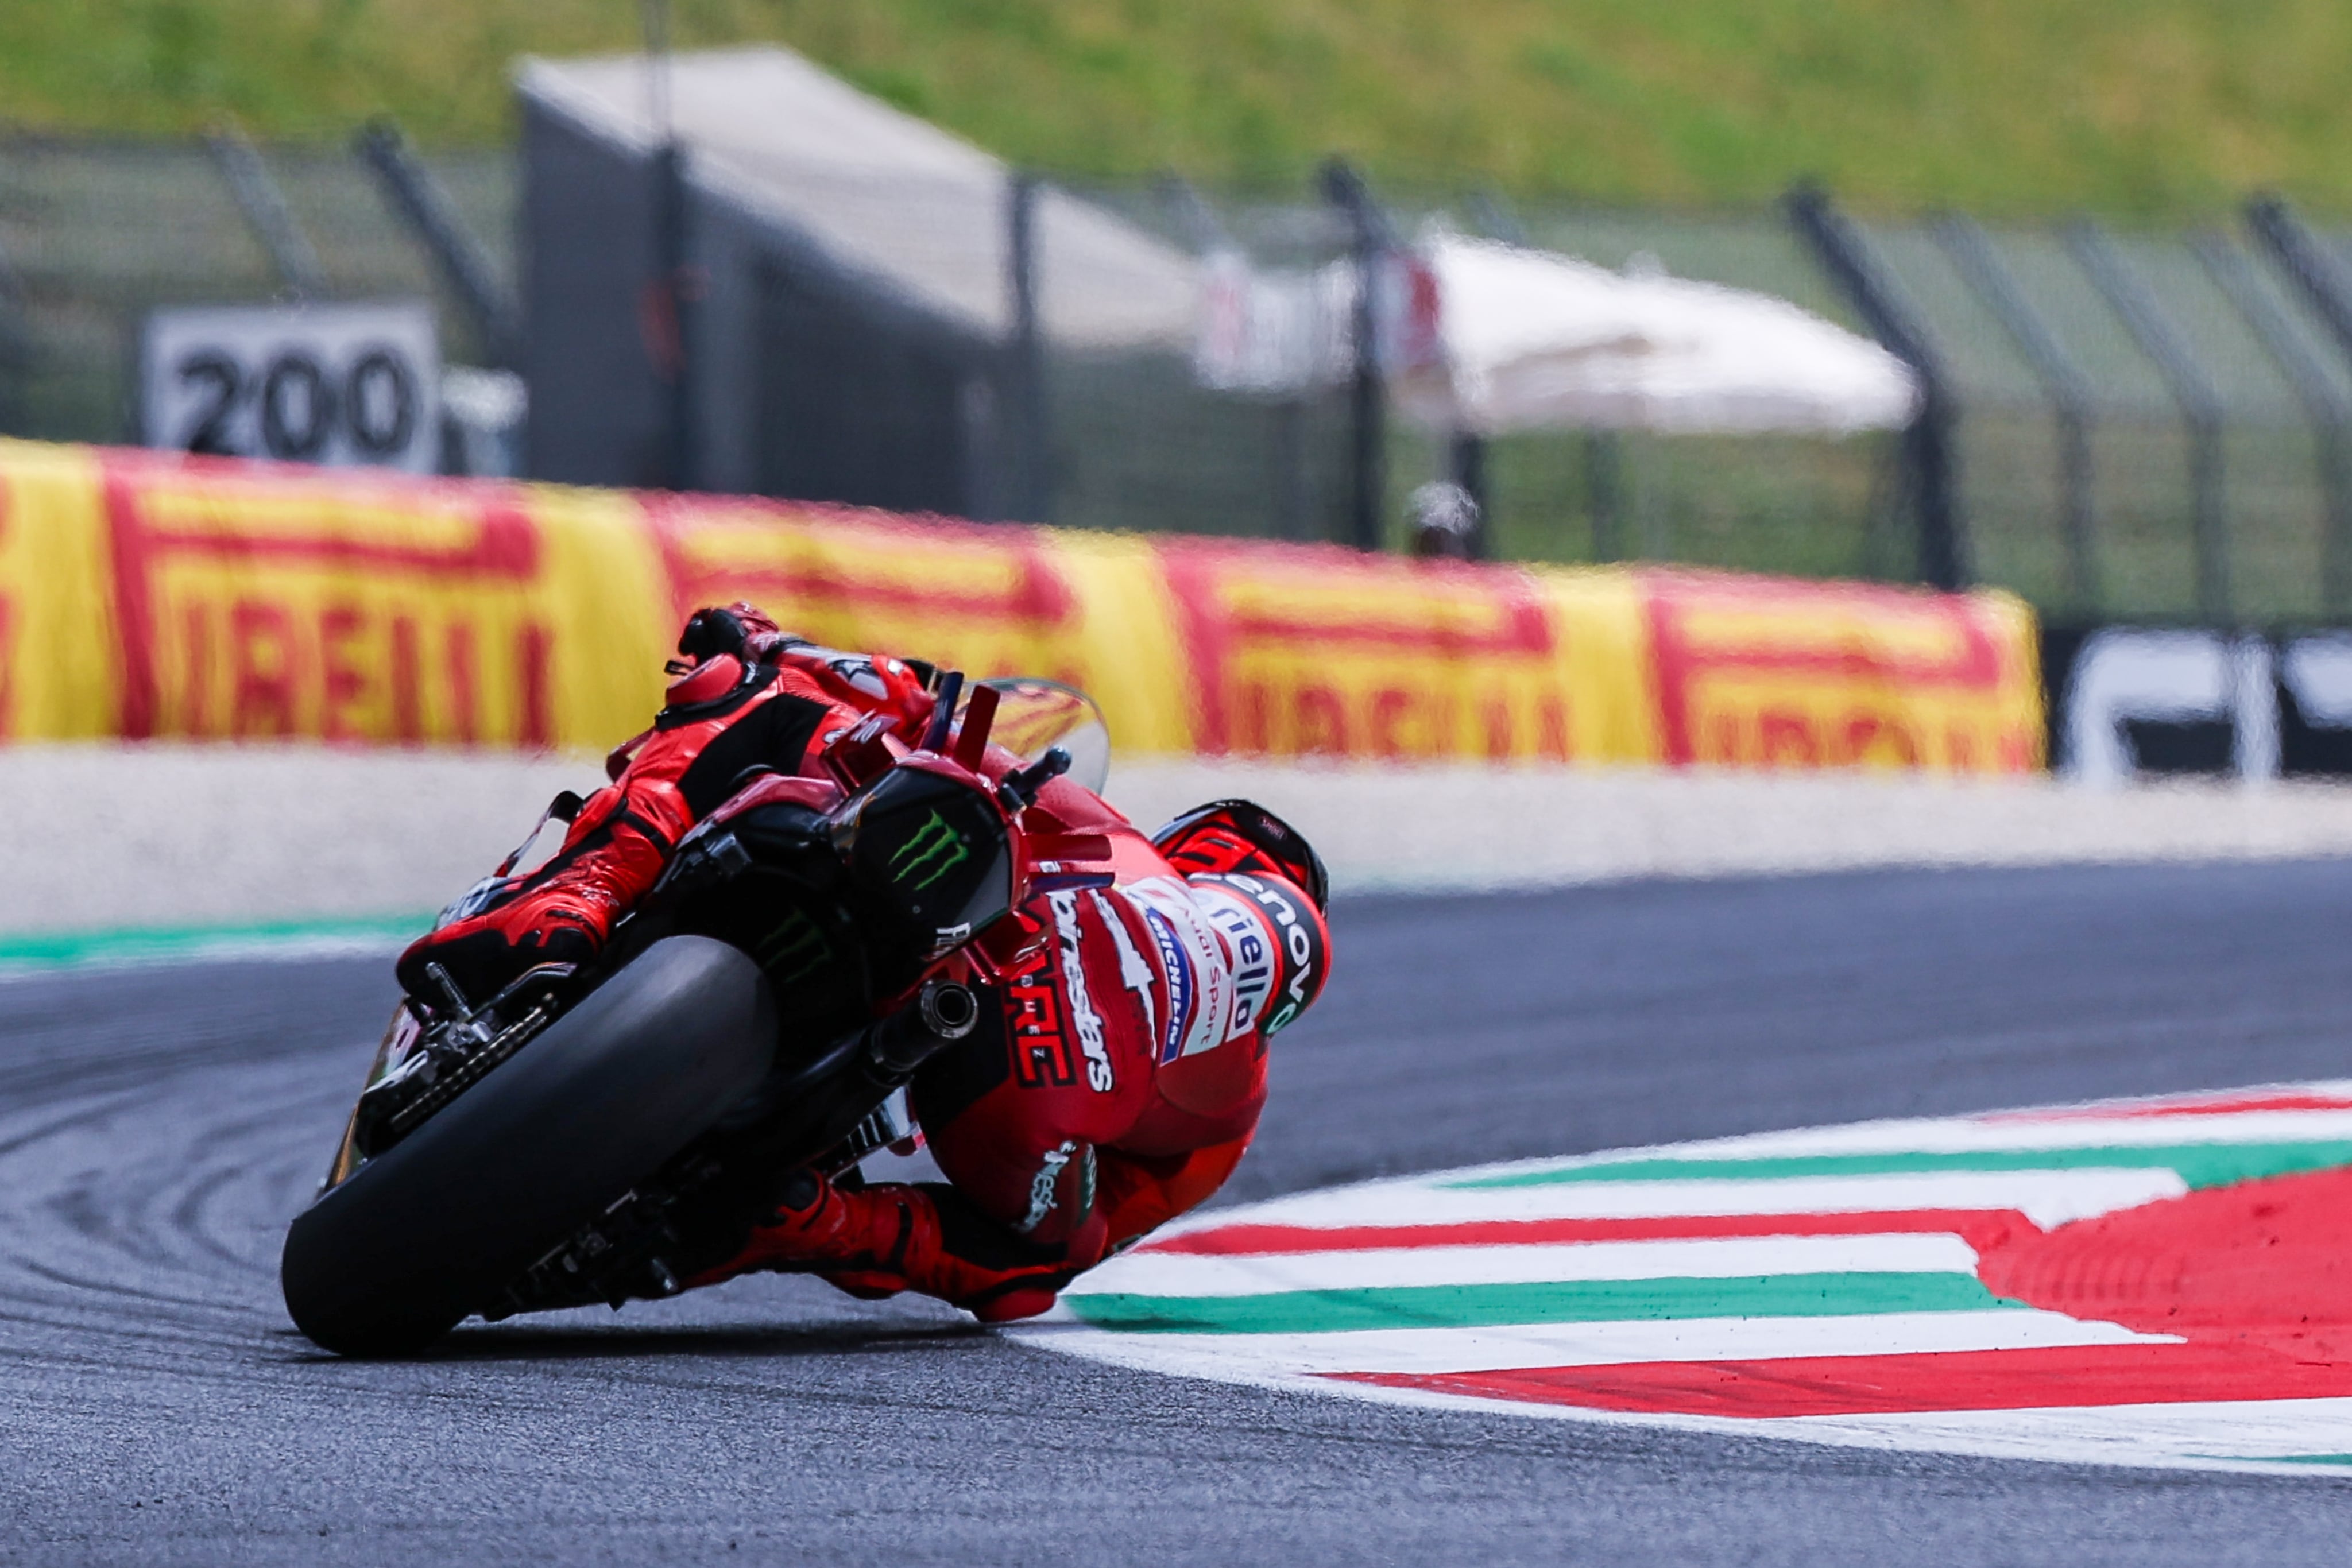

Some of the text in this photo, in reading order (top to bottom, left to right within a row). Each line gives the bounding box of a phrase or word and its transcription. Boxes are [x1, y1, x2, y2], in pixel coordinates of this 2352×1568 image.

[178, 348, 423, 461] 200
[1046, 890, 1113, 1091] pinestars
[1149, 915, 1182, 1046] MICHELIN
[1201, 966, 1221, 1045] Sport
